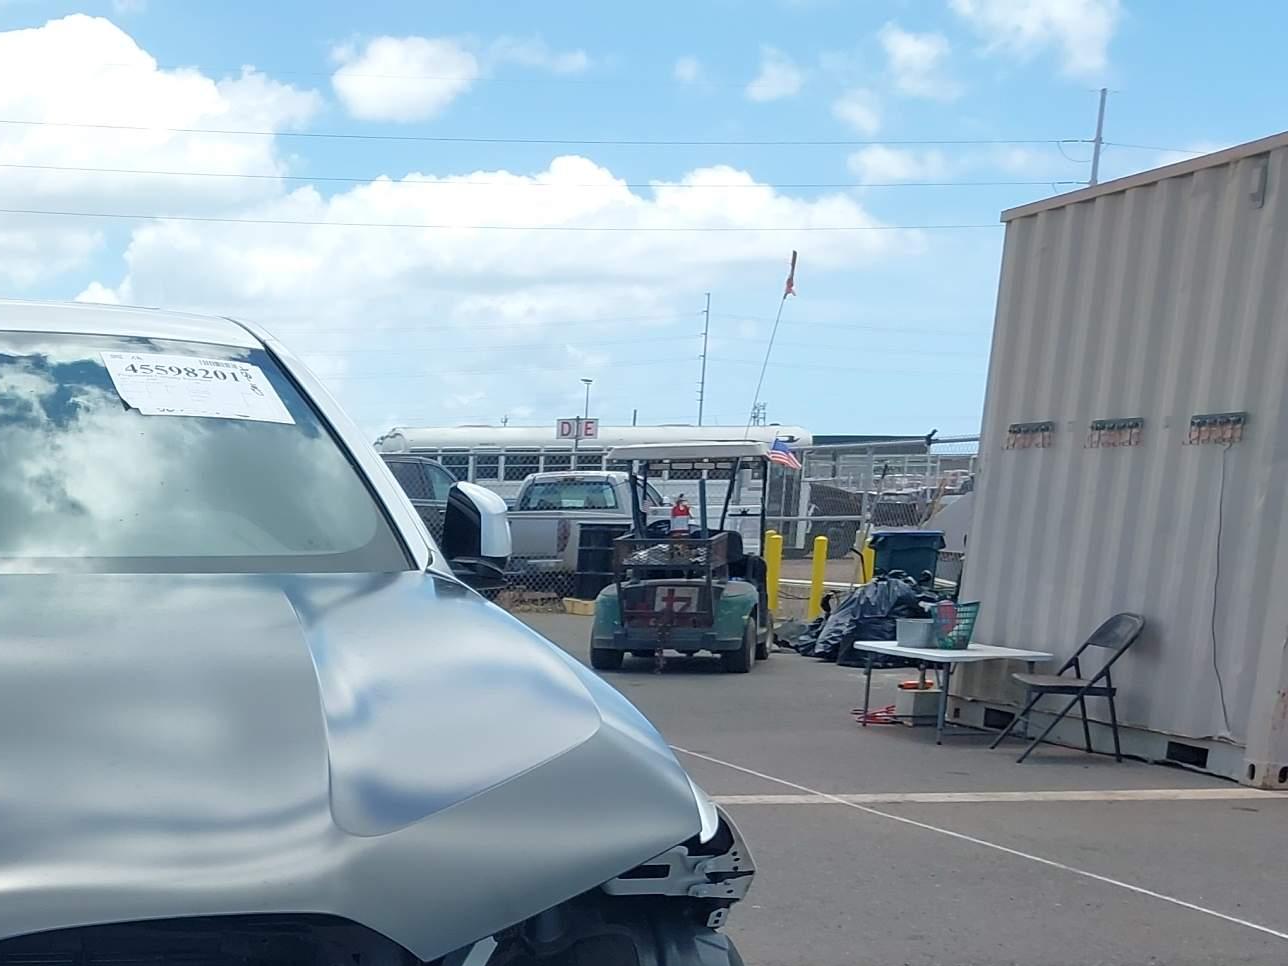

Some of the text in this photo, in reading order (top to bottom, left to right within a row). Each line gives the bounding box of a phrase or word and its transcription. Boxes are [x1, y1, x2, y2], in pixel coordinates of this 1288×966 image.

[124, 363, 241, 383] 45598201
[560, 421, 595, 437] D E
